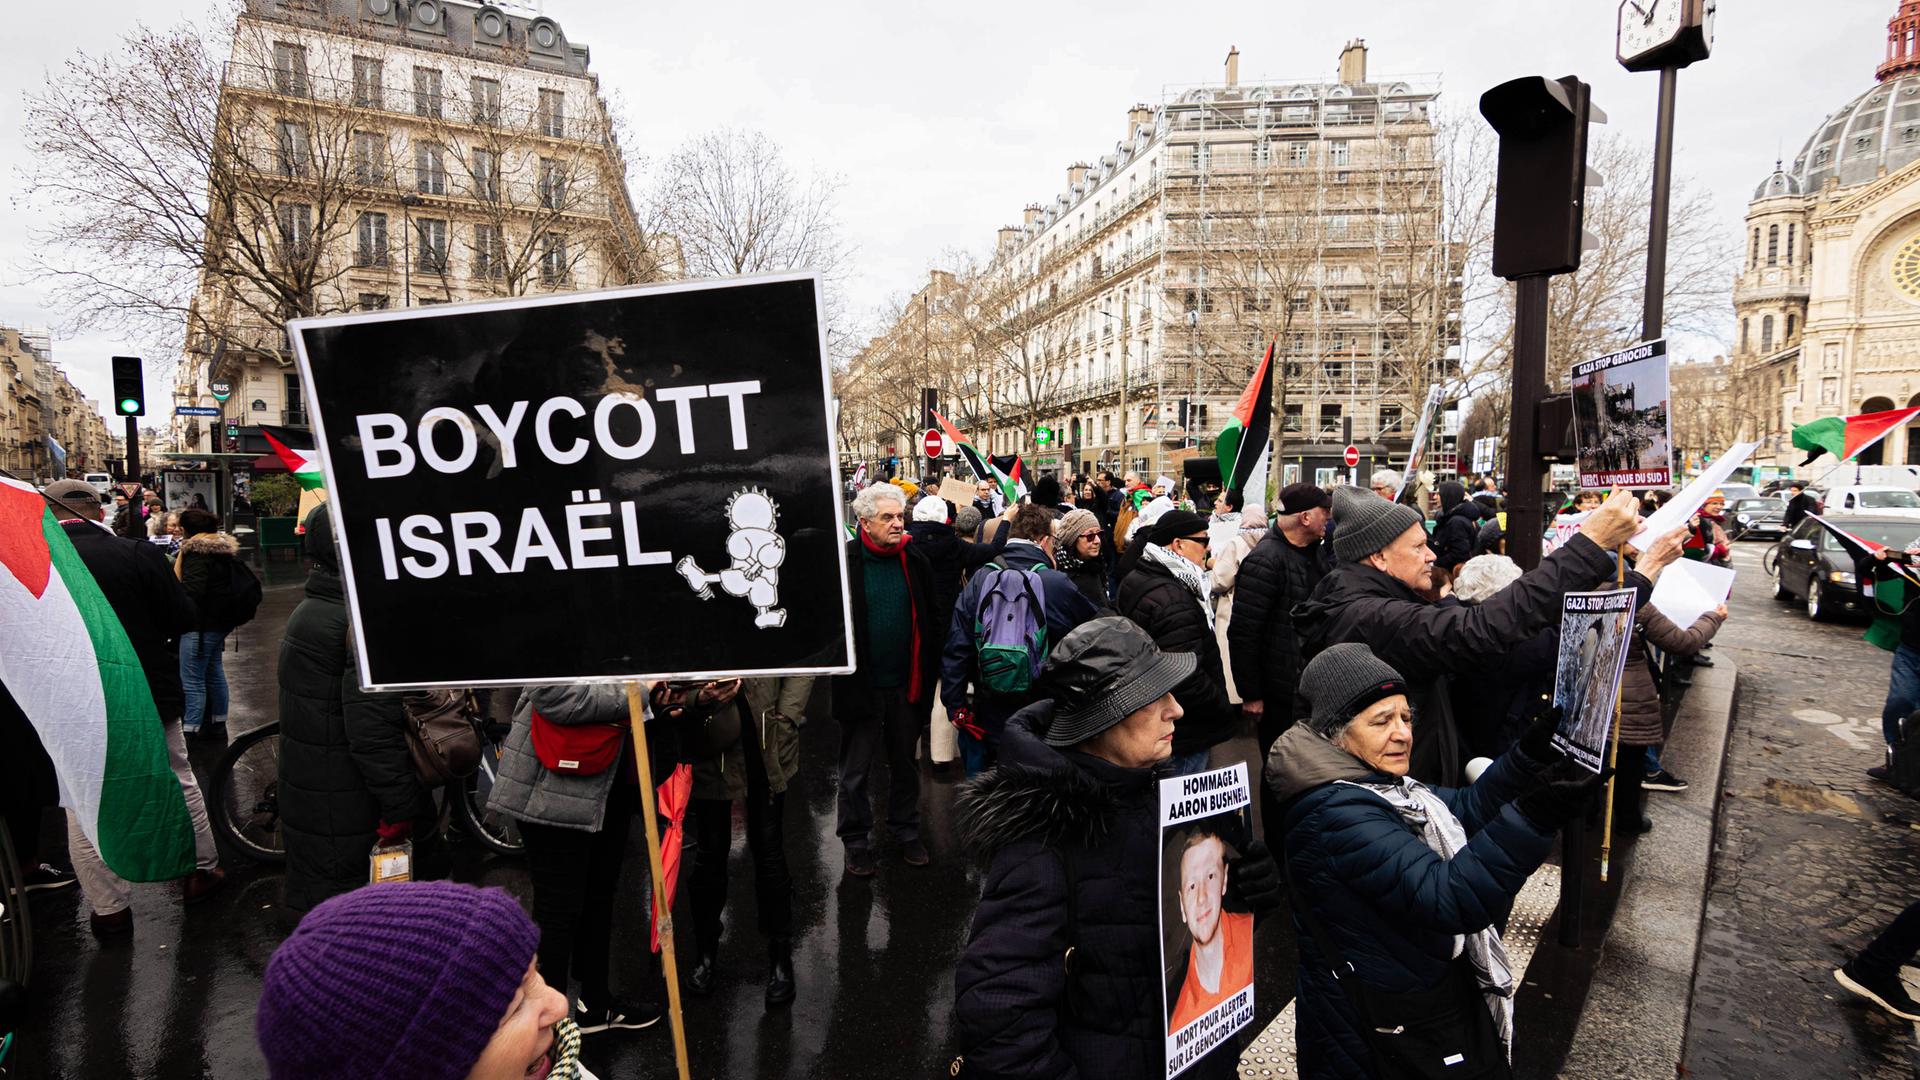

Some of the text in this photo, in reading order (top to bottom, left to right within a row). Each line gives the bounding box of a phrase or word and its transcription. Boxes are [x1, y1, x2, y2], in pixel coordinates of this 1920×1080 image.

[1579, 362, 1594, 375] GAZA
[1595, 356, 1611, 371] STOP
[213, 383, 229, 392] BUS
[356, 380, 761, 479] BOYCOTT
[1635, 472, 1646, 484] DU
[1646, 472, 1662, 483] SUD
[375, 488, 673, 580] ISRAËL
[1566, 596, 1586, 610] GAZA
[1587, 597, 1604, 610] STOP
[1183, 768, 1239, 796] HOMMAGE A
[1168, 785, 1248, 820] AARON BUSHNELL
[1176, 991, 1248, 1050] MORT POUR ALERTER
[1168, 1005, 1254, 1076] SUR LE GÉNOCIDE À GAZA
